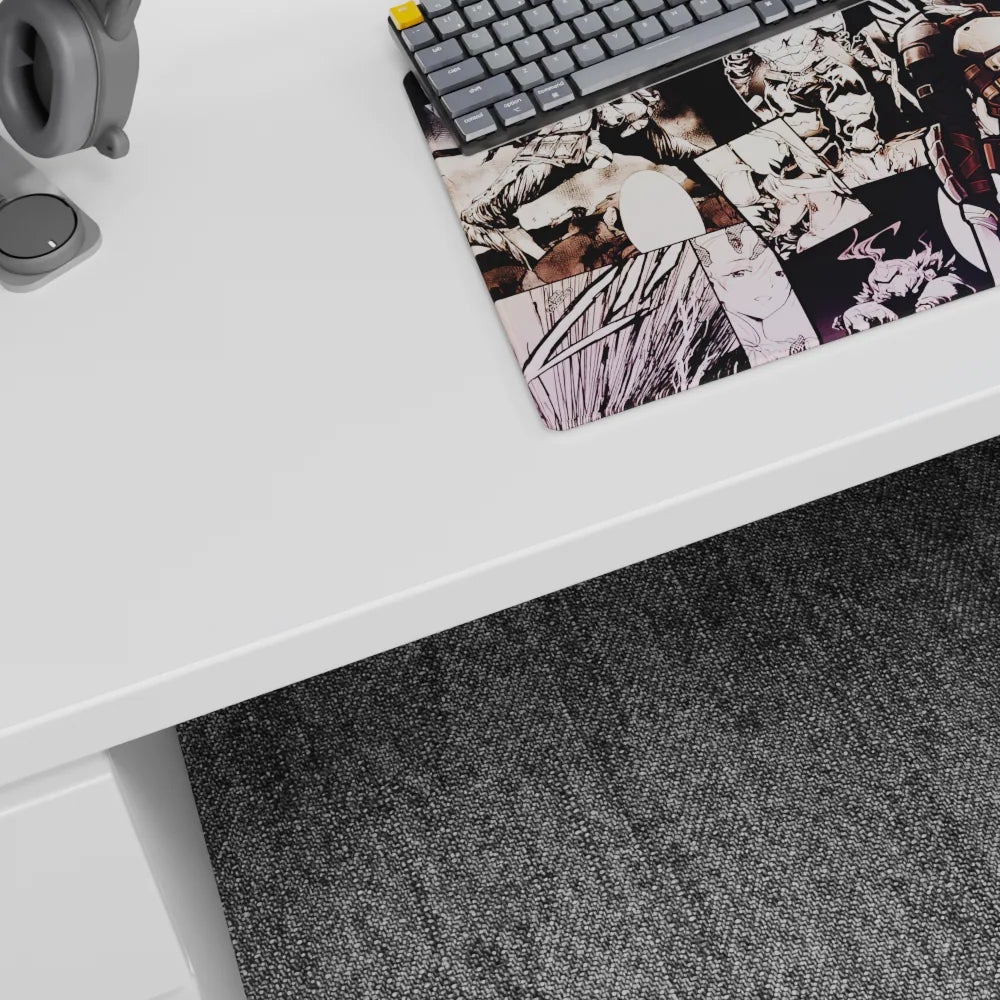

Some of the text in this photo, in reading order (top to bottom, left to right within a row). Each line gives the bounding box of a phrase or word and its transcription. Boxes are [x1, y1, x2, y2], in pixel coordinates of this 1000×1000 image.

[448, 66, 461, 74] caps
[537, 81, 564, 94] command
[504, 98, 522, 108] option
[464, 112, 484, 124] control
